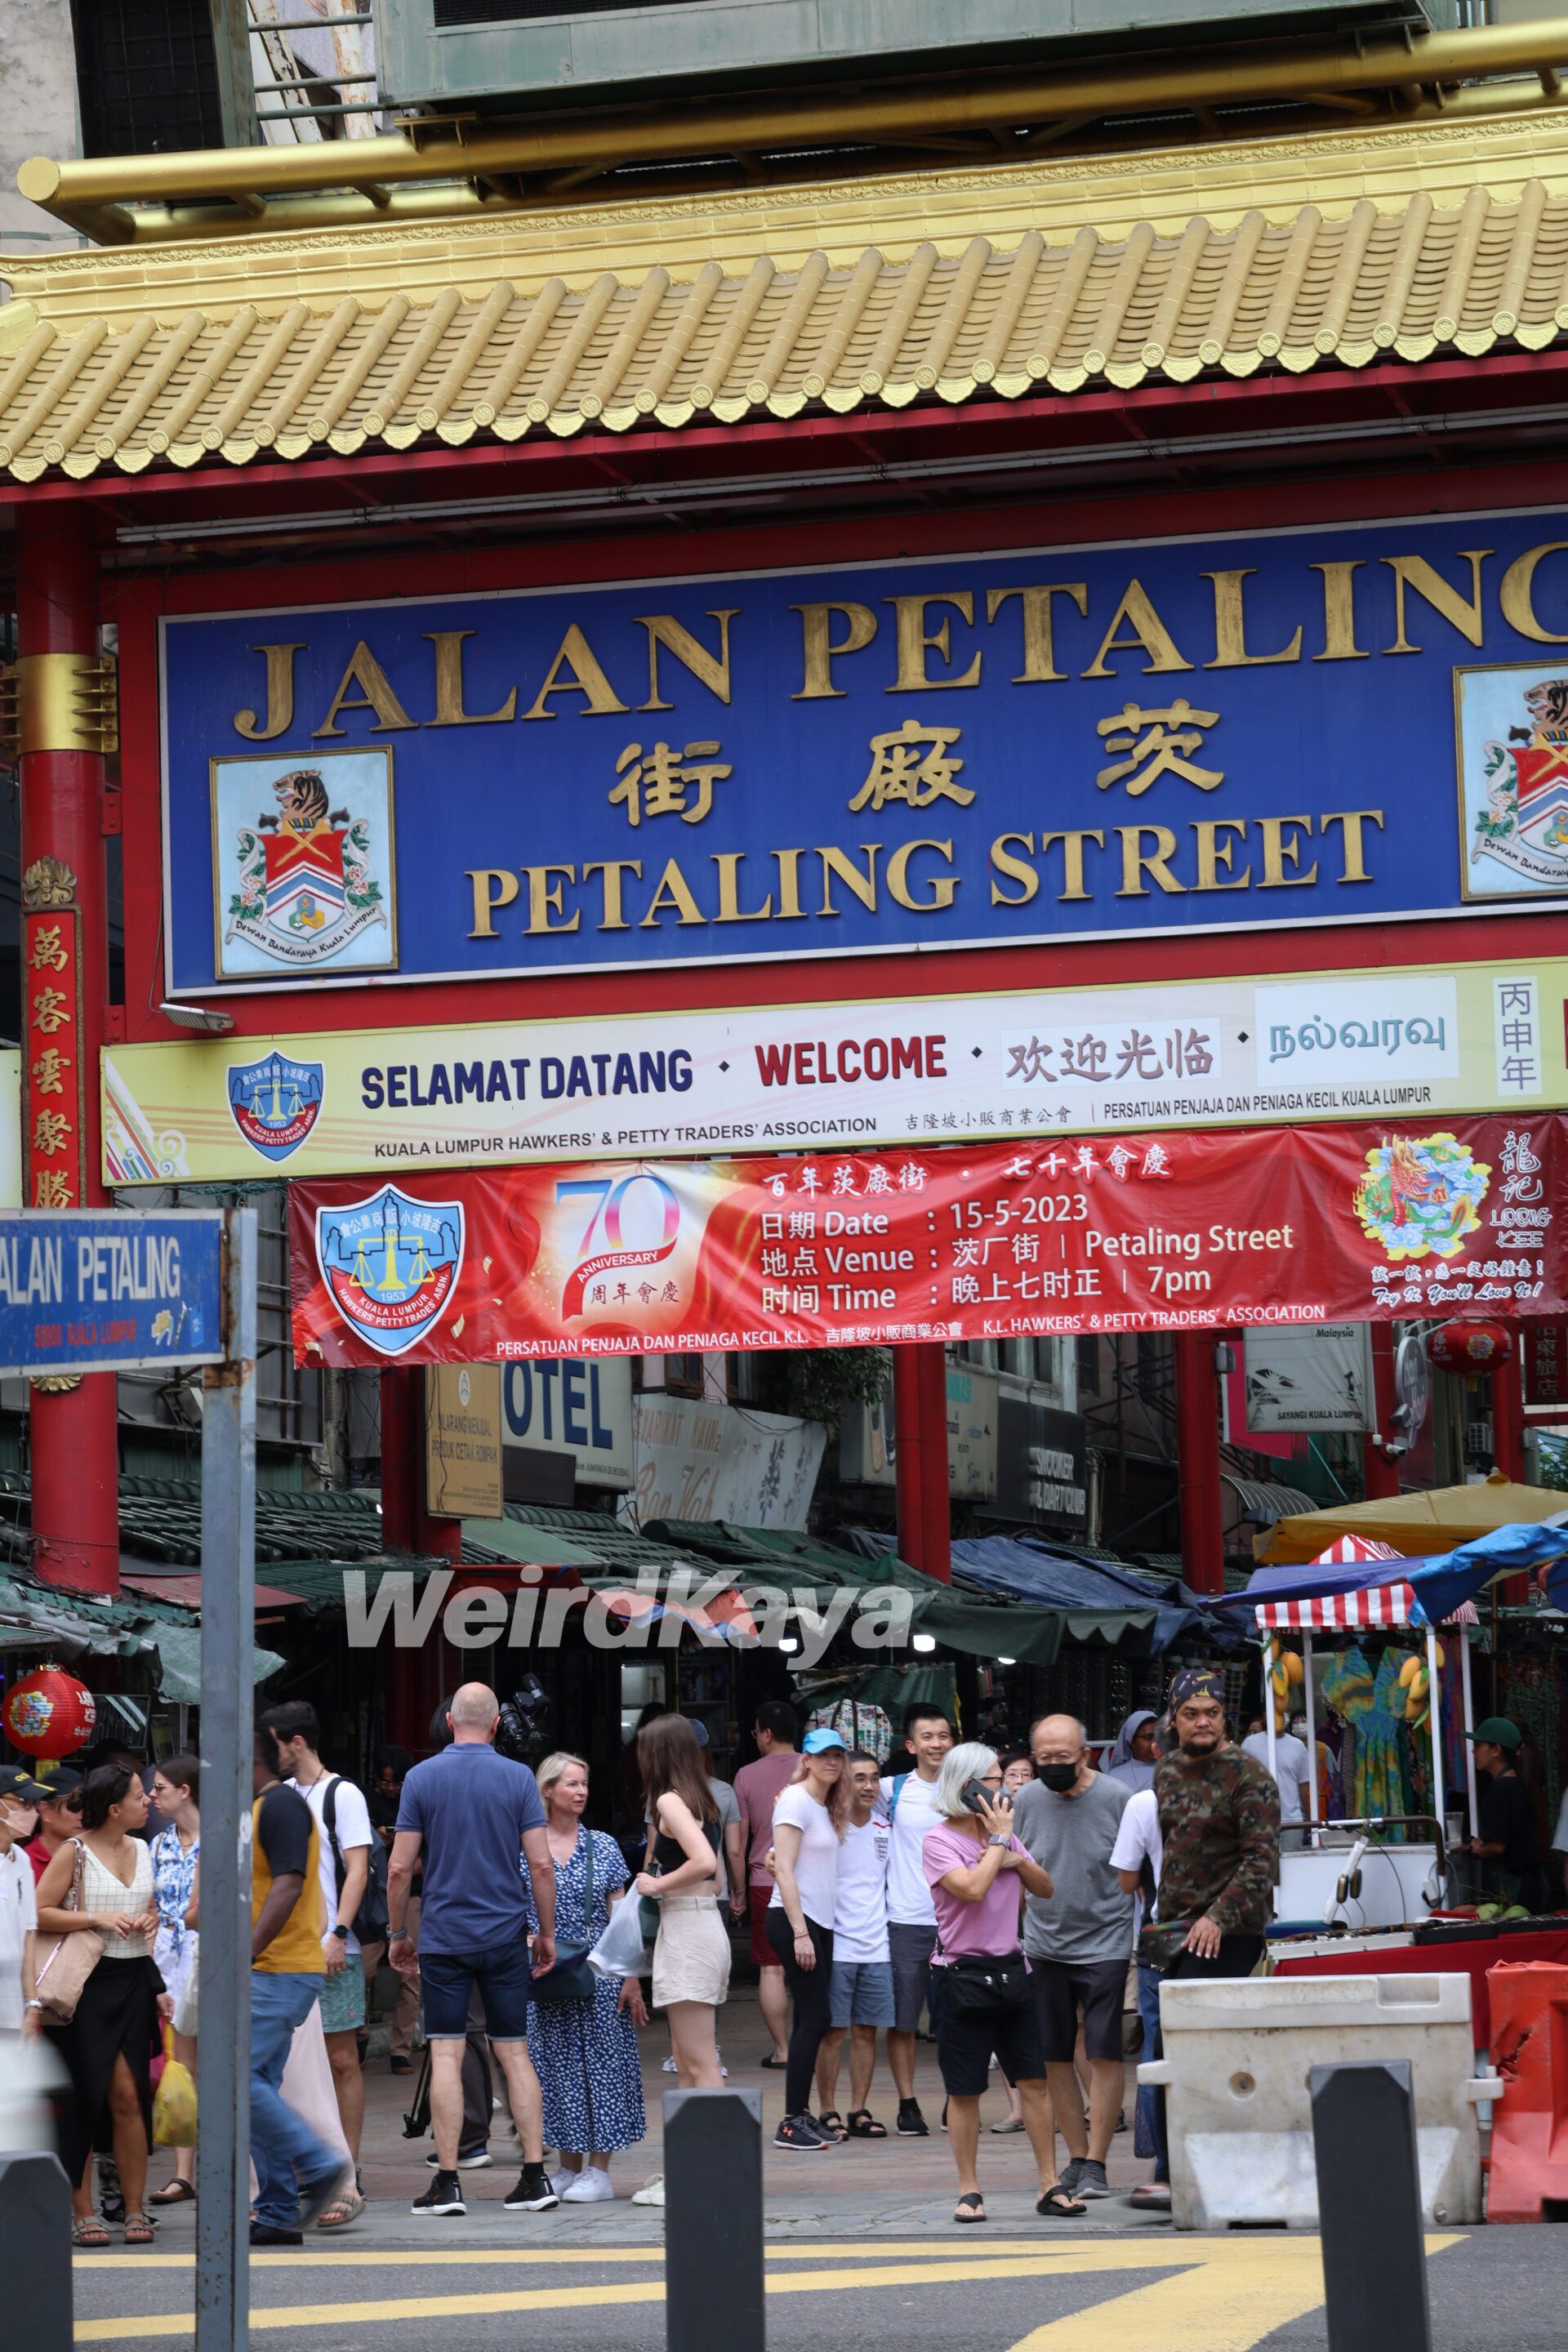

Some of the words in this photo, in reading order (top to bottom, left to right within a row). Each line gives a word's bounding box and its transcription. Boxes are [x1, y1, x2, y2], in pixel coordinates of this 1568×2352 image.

[234, 608, 742, 740] JALAN
[1484, 838, 1518, 861] Dewan
[465, 838, 960, 938] PETALING
[990, 809, 1384, 906] STREET
[235, 920, 267, 943] Dewan
[268, 937, 317, 959] Bandaraya
[319, 935, 345, 953] Kuala
[344, 906, 377, 935] Lumpur
[1268, 1014, 1446, 1062] நல்வரவு
[1498, 982, 1536, 1090] 丙申年
[755, 1034, 947, 1087] WELCOME
[1004, 1027, 1214, 1084] 欢迎光临
[361, 1058, 530, 1109] SELAMAT
[540, 1049, 693, 1099] DATANG
[906, 1105, 1072, 1130] 吉隆坡小販商業公會
[1104, 1101, 1170, 1120] PERSATUAN
[1174, 1098, 1223, 1116] PENJAJA
[1227, 1096, 1250, 1112] DAN
[1254, 1093, 1303, 1111] PENIAGA
[1306, 1090, 1339, 1108] KECIL
[1342, 1089, 1381, 1107] KUALA
[1383, 1086, 1432, 1104] LUMPUR
[254, 1124, 274, 1138] KUALA
[277, 1122, 301, 1138] LUMPUR
[375, 1143, 430, 1157] KUALA
[435, 1138, 504, 1154] LUMPUR
[509, 1133, 596, 1151] HAWKERS'
[601, 1131, 612, 1145] &
[617, 1129, 670, 1144] PETTY
[675, 1124, 759, 1141] TRADERS'
[763, 1118, 876, 1136] ASSOCIATION
[762, 1161, 929, 1200] 百年茨廠街
[1003, 1143, 1171, 1179] 七十年會慶
[556, 1174, 679, 1260] 70
[761, 1210, 815, 1240] 日期
[825, 1211, 889, 1236] Date
[950, 1193, 1089, 1230] 15-5-2023
[1490, 1207, 1553, 1227] LOONG
[761, 1246, 819, 1277] 地点
[824, 1247, 914, 1273] Venue
[952, 1232, 1040, 1268] 茨厂街
[1086, 1227, 1200, 1262] Petaling
[1209, 1224, 1294, 1253] Street
[1495, 1231, 1545, 1248] KEE
[78, 1236, 180, 1302] PETALING
[577, 1250, 659, 1283] ANNIVERSARY
[359, 1296, 389, 1316] KUALA
[392, 1294, 430, 1316] LUMPUR
[375, 1316, 403, 1326] PETTY
[434, 1274, 449, 1300] ASSN.
[381, 1291, 406, 1302] 1953
[591, 1280, 680, 1305] 周年會慶
[762, 1284, 819, 1314] 时间
[826, 1283, 897, 1311] Time
[952, 1267, 1102, 1305] 晚上七时正
[1147, 1266, 1211, 1298] 7pm
[1372, 1287, 1401, 1307] Try
[1428, 1281, 1473, 1305] You'll
[1474, 1281, 1512, 1299] Love
[67, 1322, 97, 1346] KUALA
[100, 1319, 136, 1344] LUMPUR
[825, 1321, 963, 1343] 吉隆坡小販商業公會
[983, 1320, 1008, 1334] K.L.
[1089, 1315, 1102, 1328] &
[1104, 1312, 1147, 1327] PETTY
[1227, 1304, 1325, 1322] ASSOCIATION
[1316, 1326, 1354, 1340] Malaysia
[496, 1339, 578, 1356] PERSATUAN
[581, 1336, 641, 1353] PENJAJA
[644, 1334, 675, 1349] DAN
[678, 1332, 737, 1348] PENIAGA
[742, 1330, 781, 1346] KECIL
[783, 1330, 808, 1344] K.L.
[503, 1358, 612, 1450] OTEL
[1276, 1410, 1307, 1420] SAYANGI
[1308, 1410, 1332, 1419] KUALA
[456, 1441, 474, 1461] CETAK
[1044, 1482, 1062, 1511] DART
[1064, 1486, 1086, 1515] CLUB
